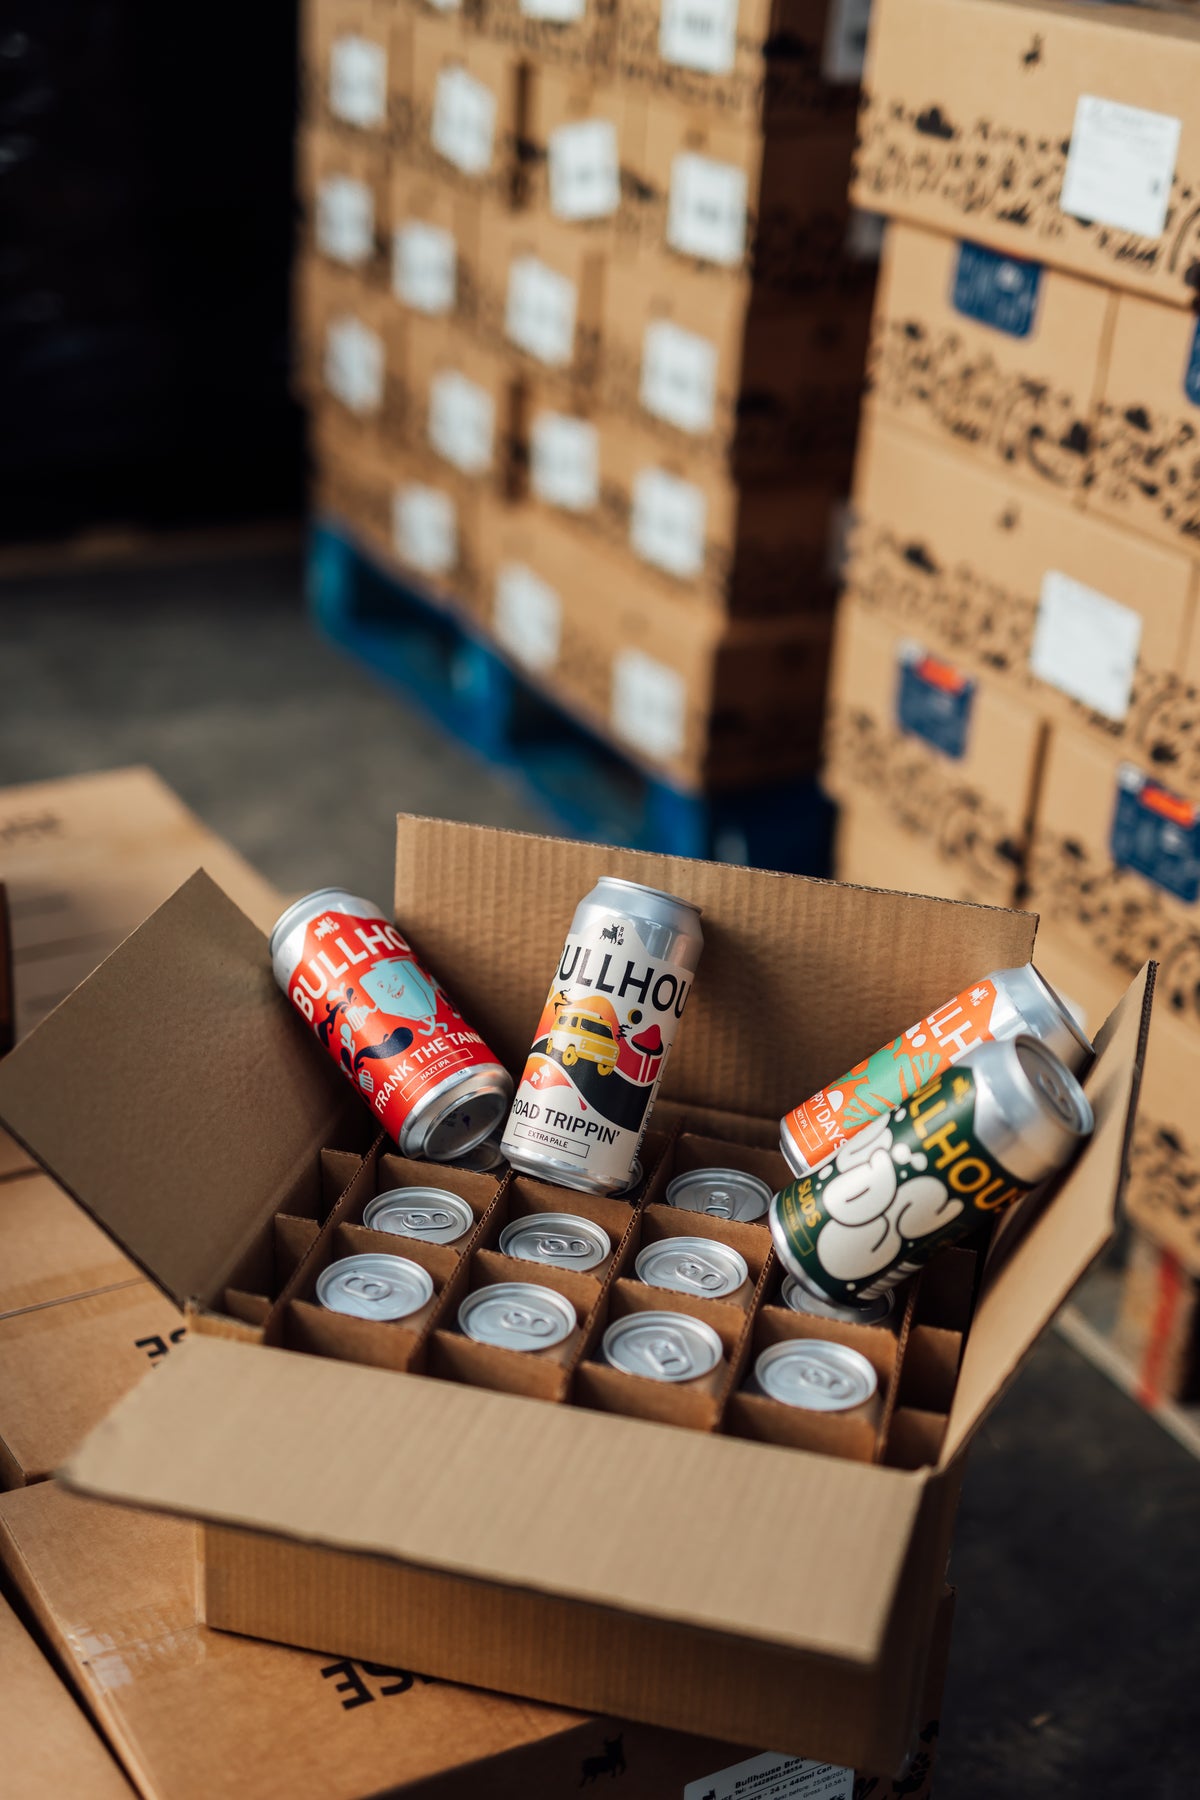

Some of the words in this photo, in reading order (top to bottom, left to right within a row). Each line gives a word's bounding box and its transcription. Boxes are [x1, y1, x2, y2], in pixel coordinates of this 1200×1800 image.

[558, 943, 692, 1019] ULLHOU
[374, 1059, 414, 1114] FRANK
[410, 1037, 450, 1063] THE
[420, 1063, 438, 1081] HAZY
[437, 1059, 450, 1070] IPA
[528, 1130, 549, 1143] EXTRA
[549, 1138, 569, 1149] PALE
[544, 1108, 620, 1145] TRIPPIN'
[798, 1178, 822, 1228] SUDS
[735, 1766, 781, 1789] Bullhouse
[770, 1786, 780, 1795] 24
[790, 1771, 815, 1786] 440ml
